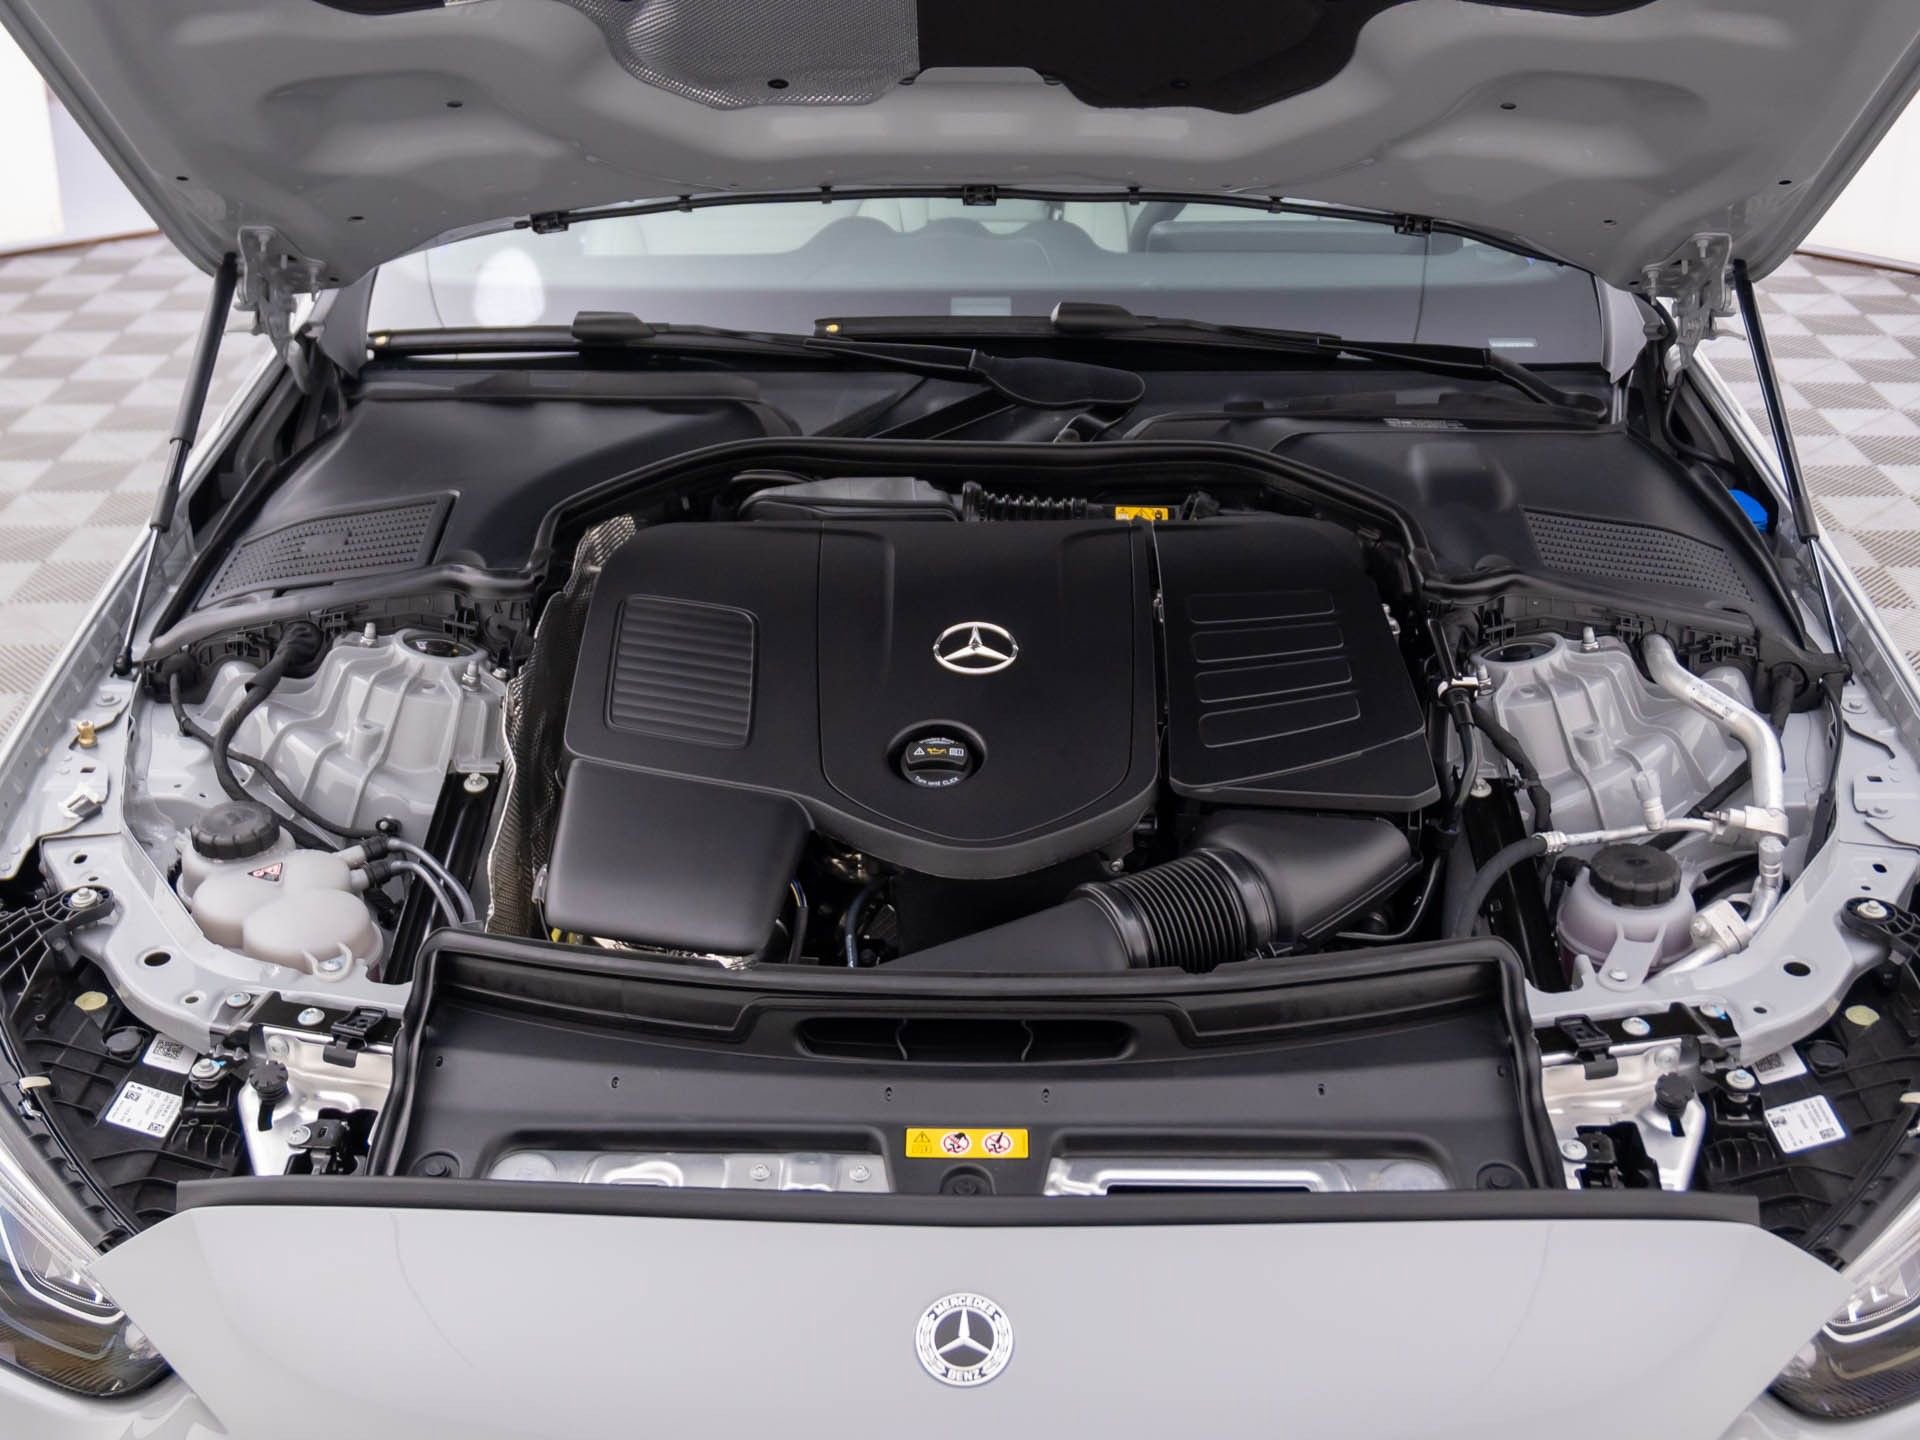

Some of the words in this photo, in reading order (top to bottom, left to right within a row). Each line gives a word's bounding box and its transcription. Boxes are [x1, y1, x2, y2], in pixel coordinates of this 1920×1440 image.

[942, 777, 959, 786] CLICK
[933, 1295, 996, 1316] MERCEDES
[947, 1368, 982, 1382] BENZ
